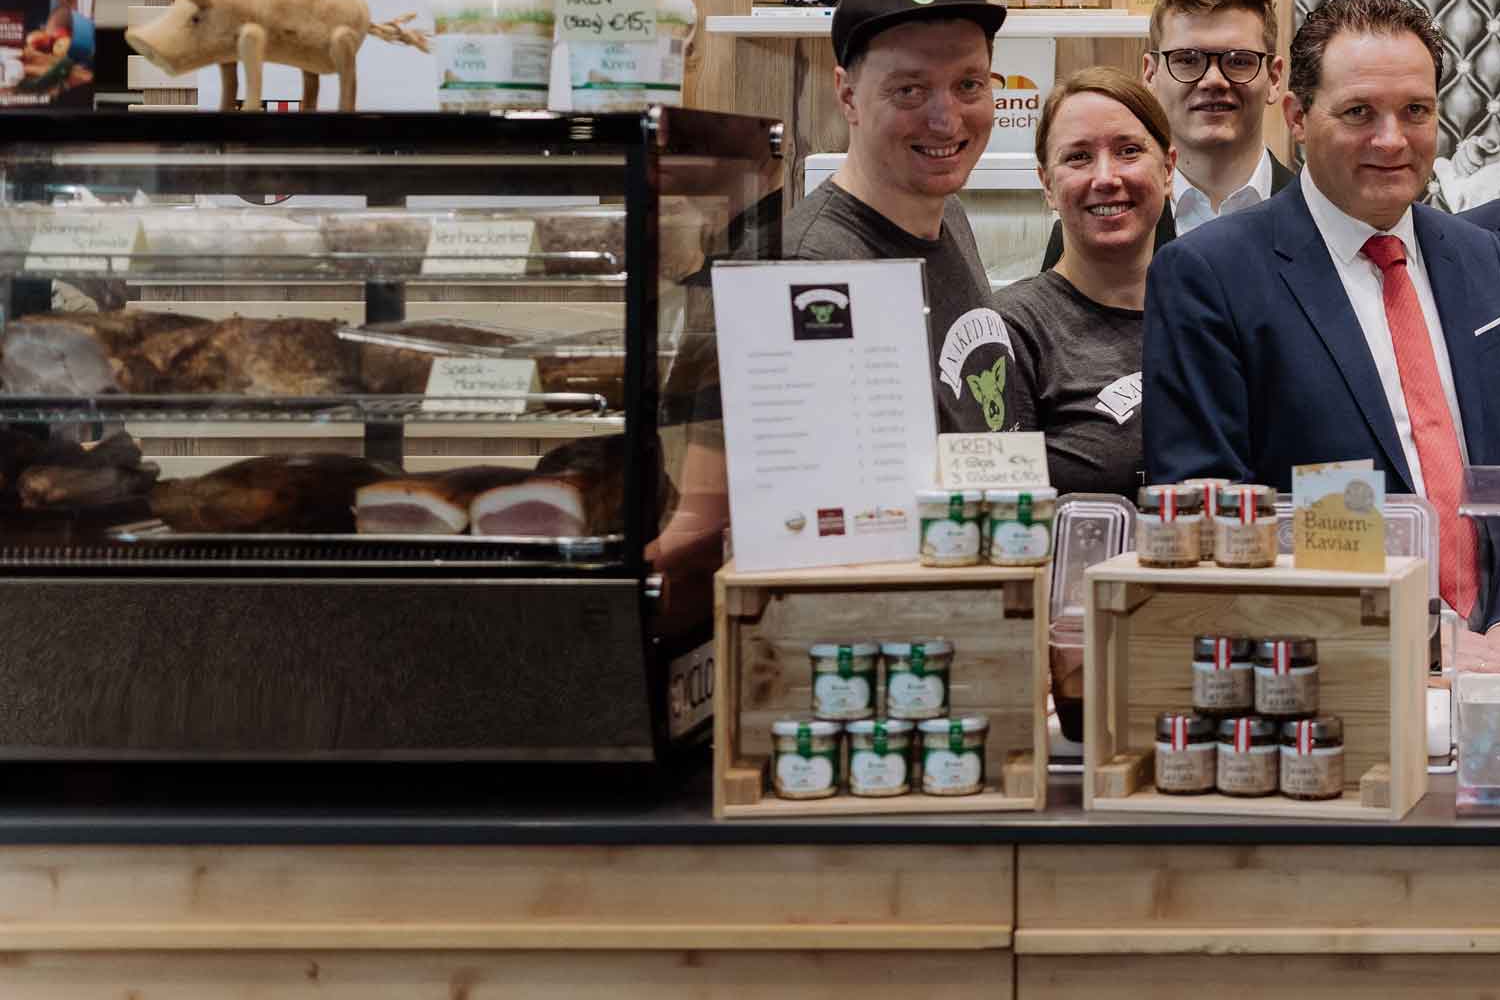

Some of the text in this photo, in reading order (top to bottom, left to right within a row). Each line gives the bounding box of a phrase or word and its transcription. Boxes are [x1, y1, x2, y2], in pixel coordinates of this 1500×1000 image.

[951, 438, 1004, 454] KREN
[1303, 511, 1374, 533] Bauern-
[1304, 532, 1359, 552] Kaviar
